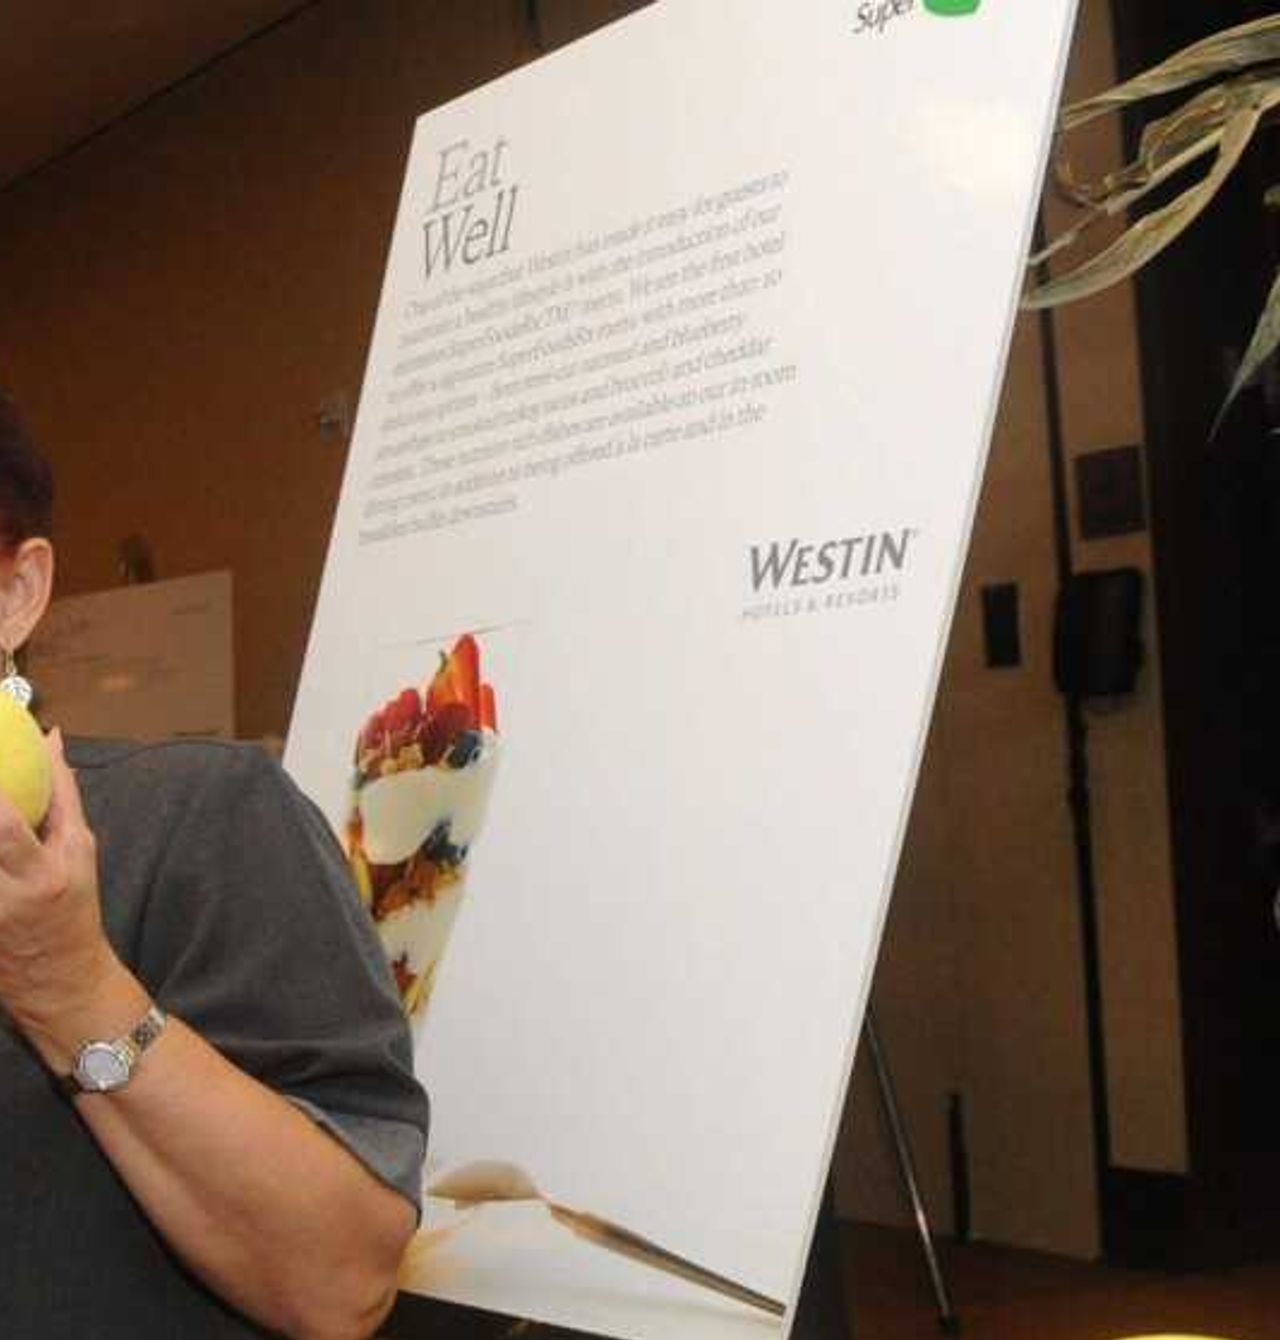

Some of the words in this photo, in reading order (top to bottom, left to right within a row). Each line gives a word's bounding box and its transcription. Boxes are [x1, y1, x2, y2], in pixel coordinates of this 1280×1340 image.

[428, 138, 510, 211] Eat
[421, 185, 519, 280] Well
[749, 527, 912, 594] WESTIN
